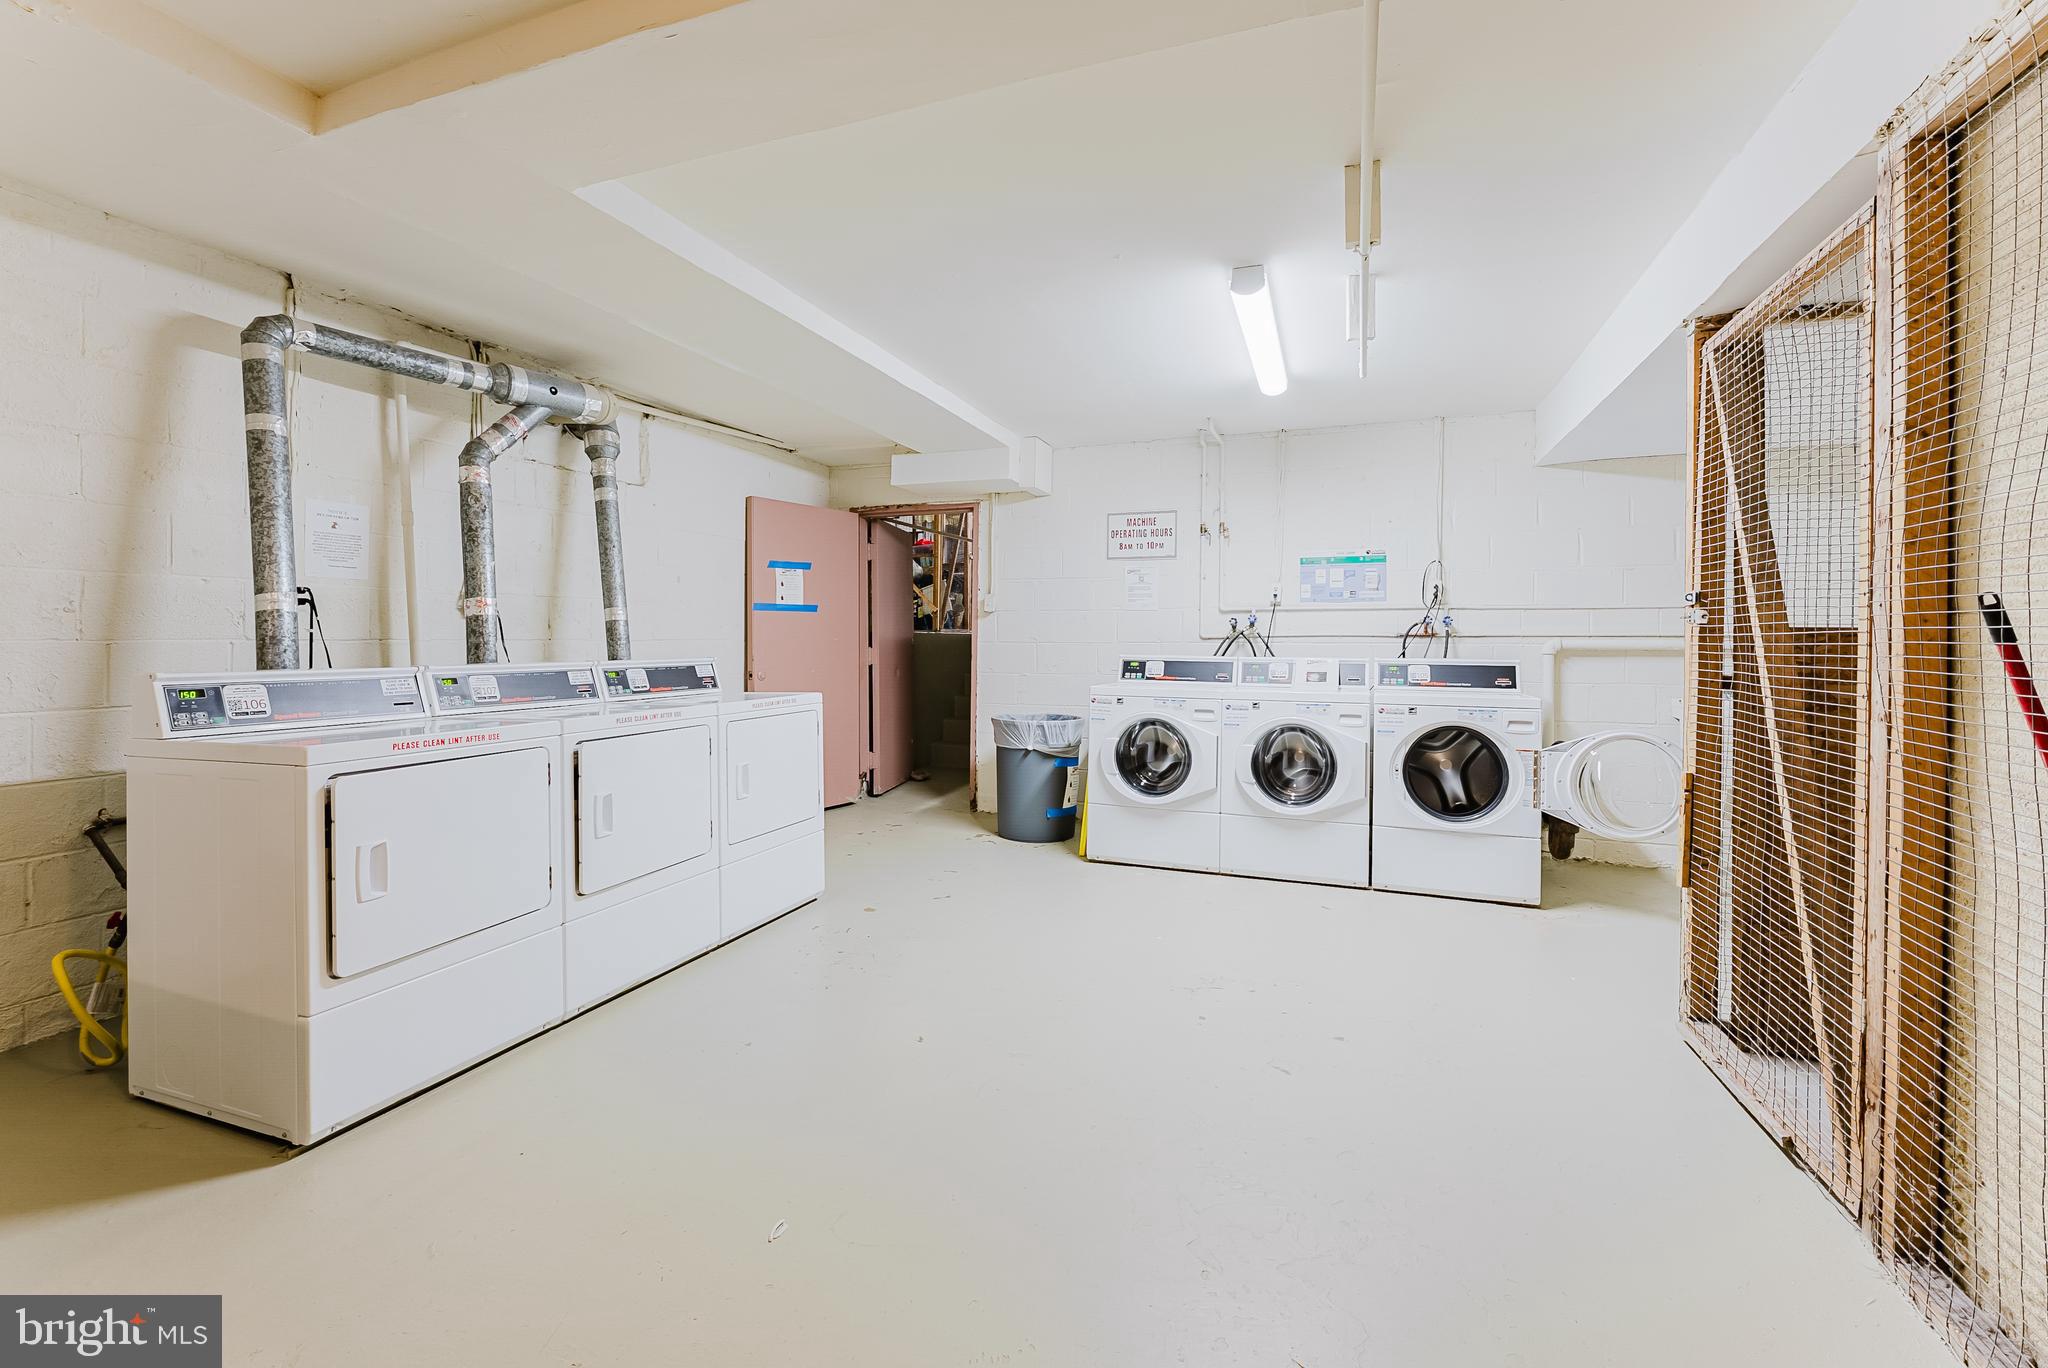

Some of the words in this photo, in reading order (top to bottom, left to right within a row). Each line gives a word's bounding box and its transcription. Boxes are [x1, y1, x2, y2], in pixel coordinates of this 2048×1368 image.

[1126, 517, 1157, 527] MACHINE
[1110, 528, 1148, 539] OPERATING
[1150, 527, 1173, 537] HOURS
[1119, 542, 1133, 550] 8AM
[1146, 541, 1164, 549] 10PM
[482, 686, 497, 695] 107
[243, 698, 267, 710] 106
[616, 716, 633, 724] PLEASE
[634, 714, 648, 722] CLEAN
[392, 740, 420, 750] PLEASE
[423, 738, 446, 748] CLEAN
[448, 736, 463, 745] LINT
[465, 734, 486, 743] AFTER
[488, 732, 500, 740] USE
